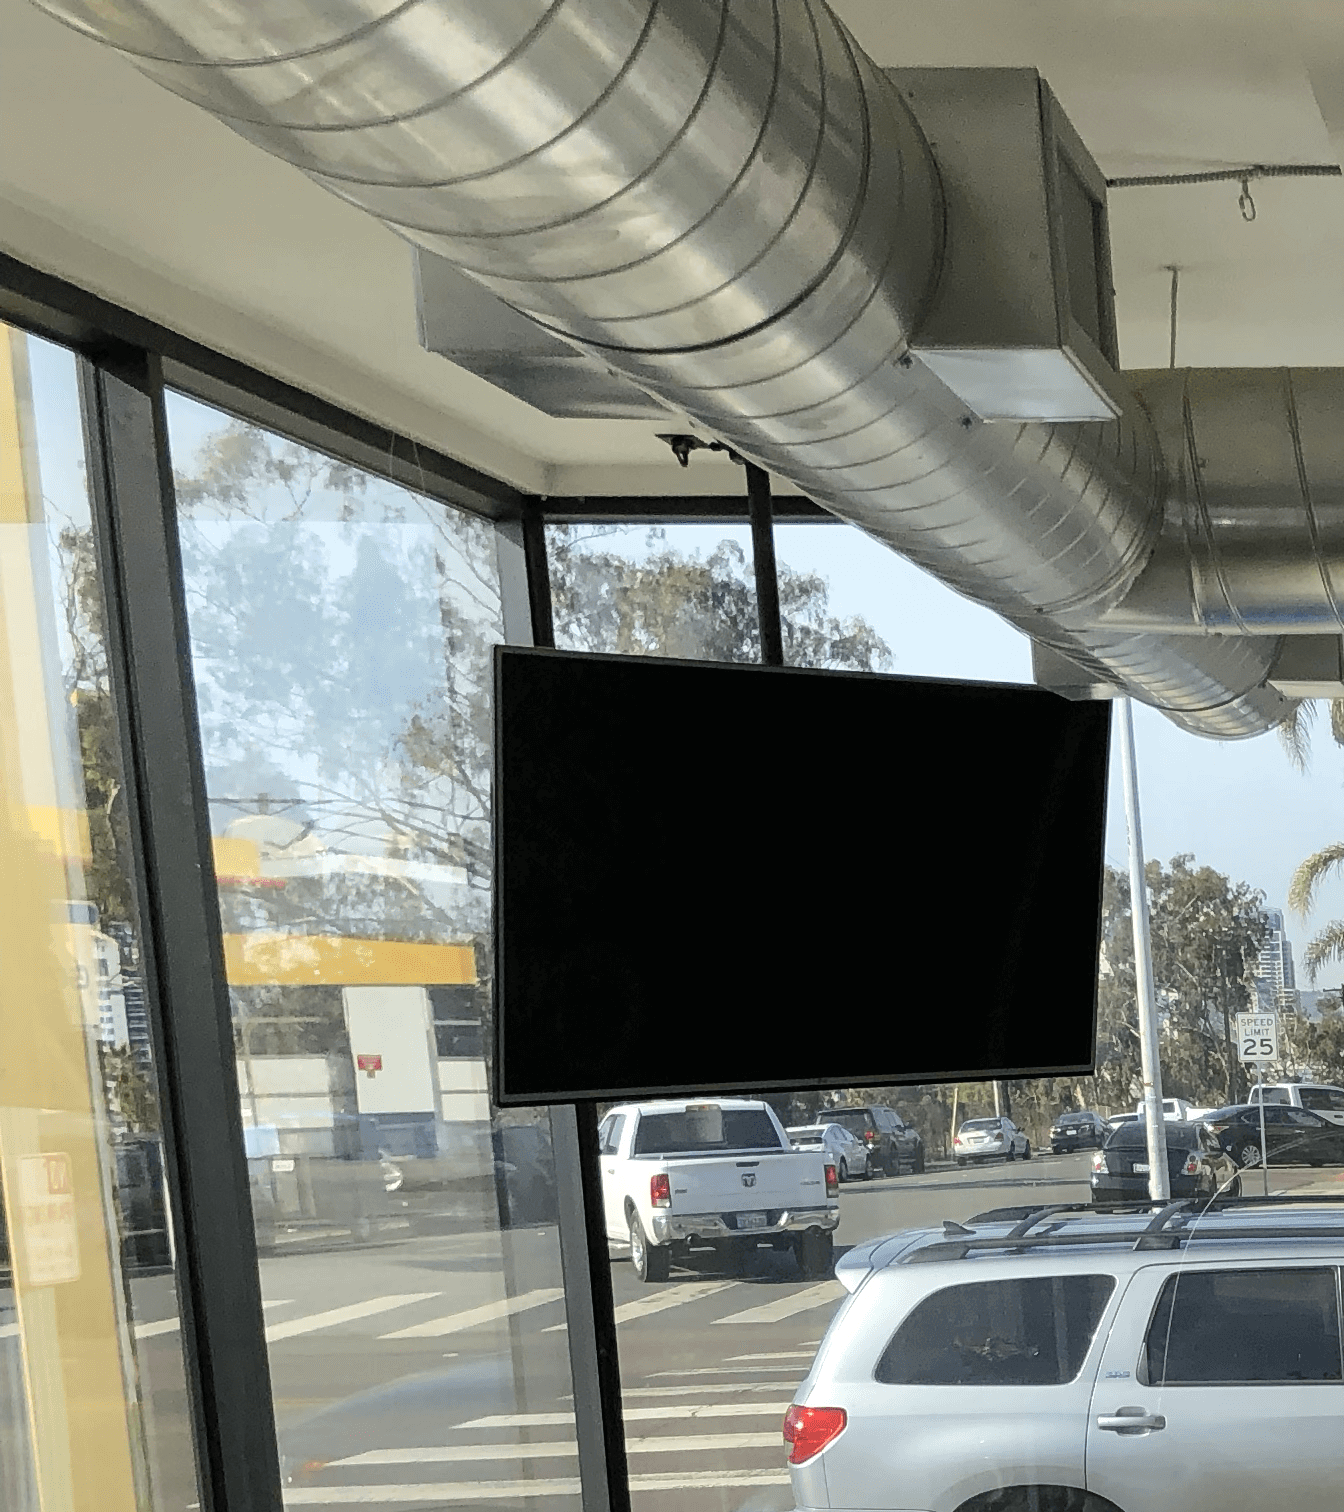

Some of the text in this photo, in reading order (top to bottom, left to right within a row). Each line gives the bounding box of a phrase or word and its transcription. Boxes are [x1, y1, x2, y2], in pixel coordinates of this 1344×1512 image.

[1241, 1018, 1274, 1027] SPEED
[1244, 1028, 1270, 1037] LIMIT
[1243, 1038, 1274, 1056] 25
